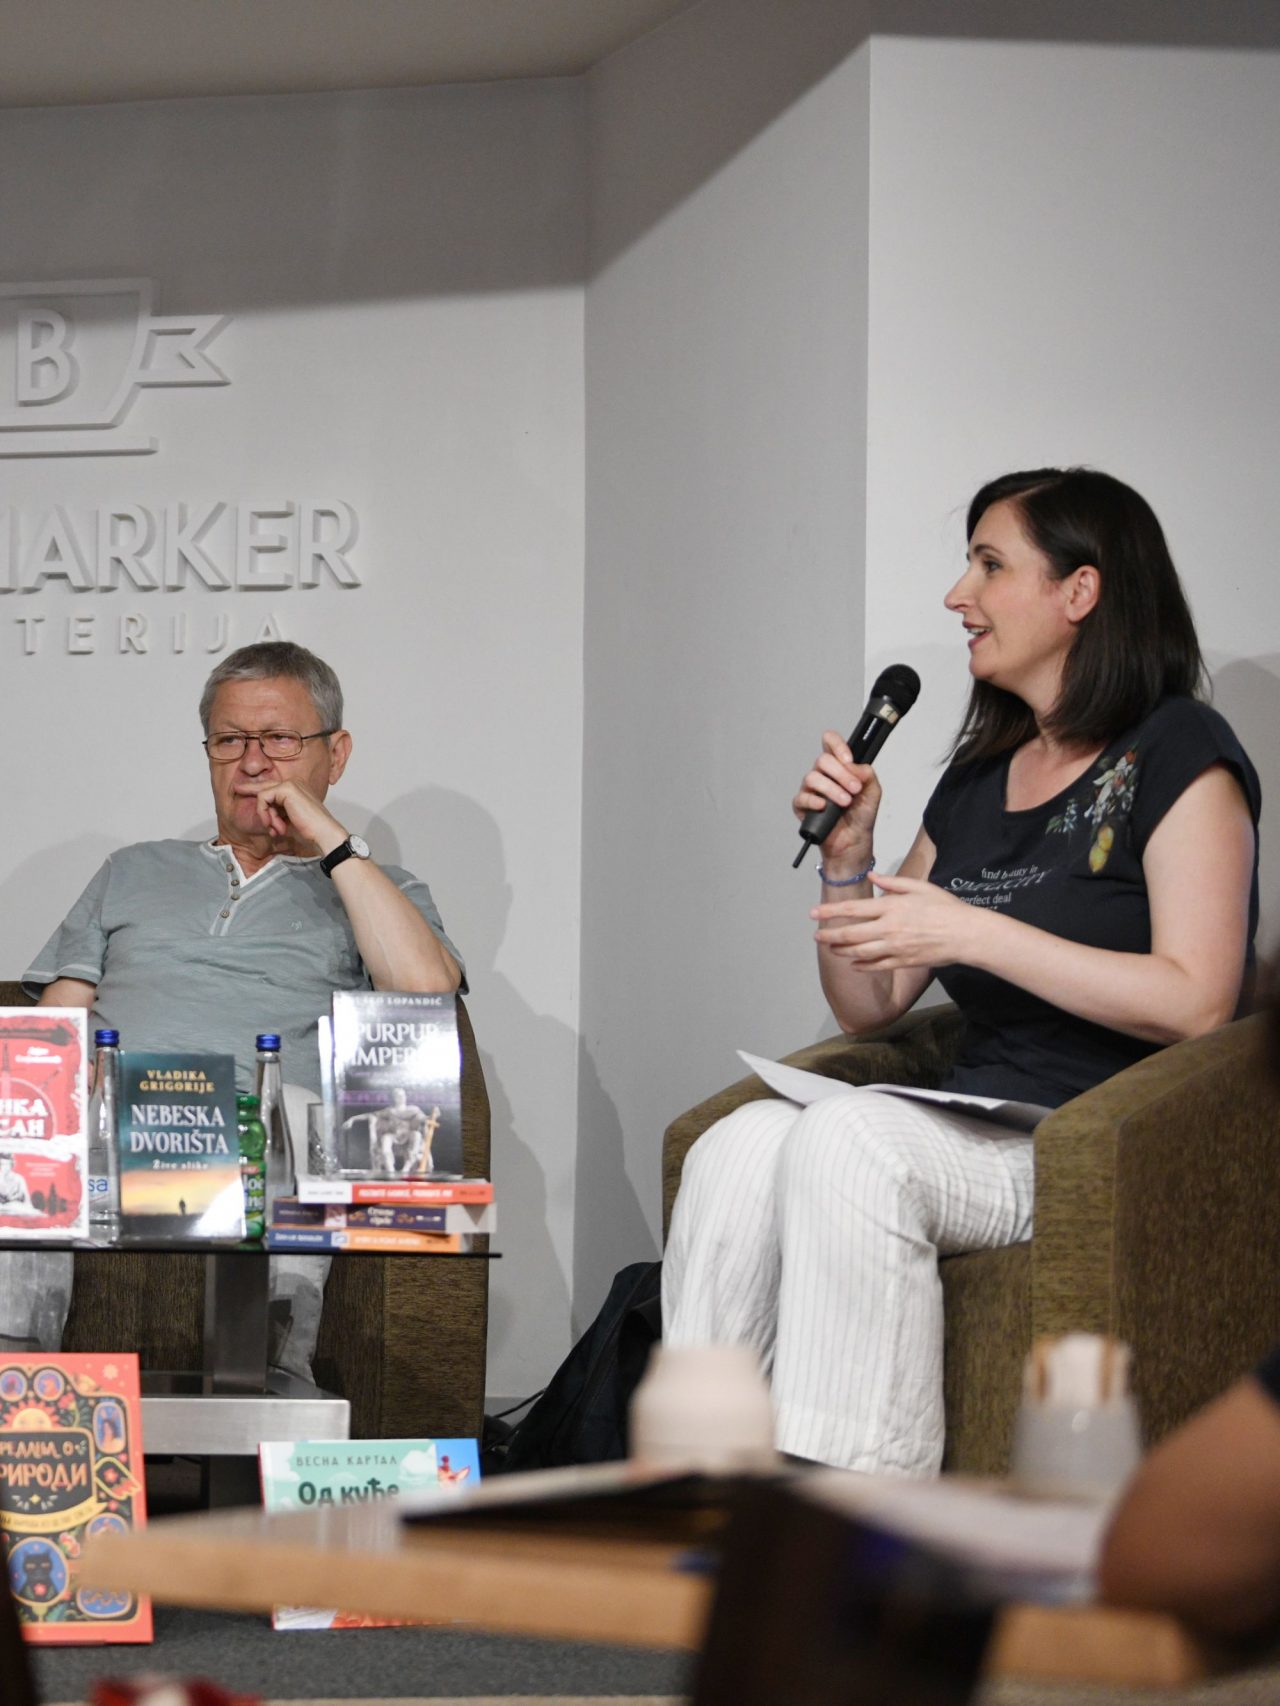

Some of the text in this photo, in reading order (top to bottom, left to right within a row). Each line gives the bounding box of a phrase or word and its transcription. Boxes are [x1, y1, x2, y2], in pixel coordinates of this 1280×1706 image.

[992, 892, 1012, 904] deal
[146, 1069, 207, 1081] VLADIKA
[139, 1080, 215, 1094] GRIGORIJE
[130, 1104, 226, 1128] NEBESKA
[129, 1128, 230, 1155] DVORIŠTA
[296, 1454, 398, 1467] ВЕСНА КАРТАЛ
